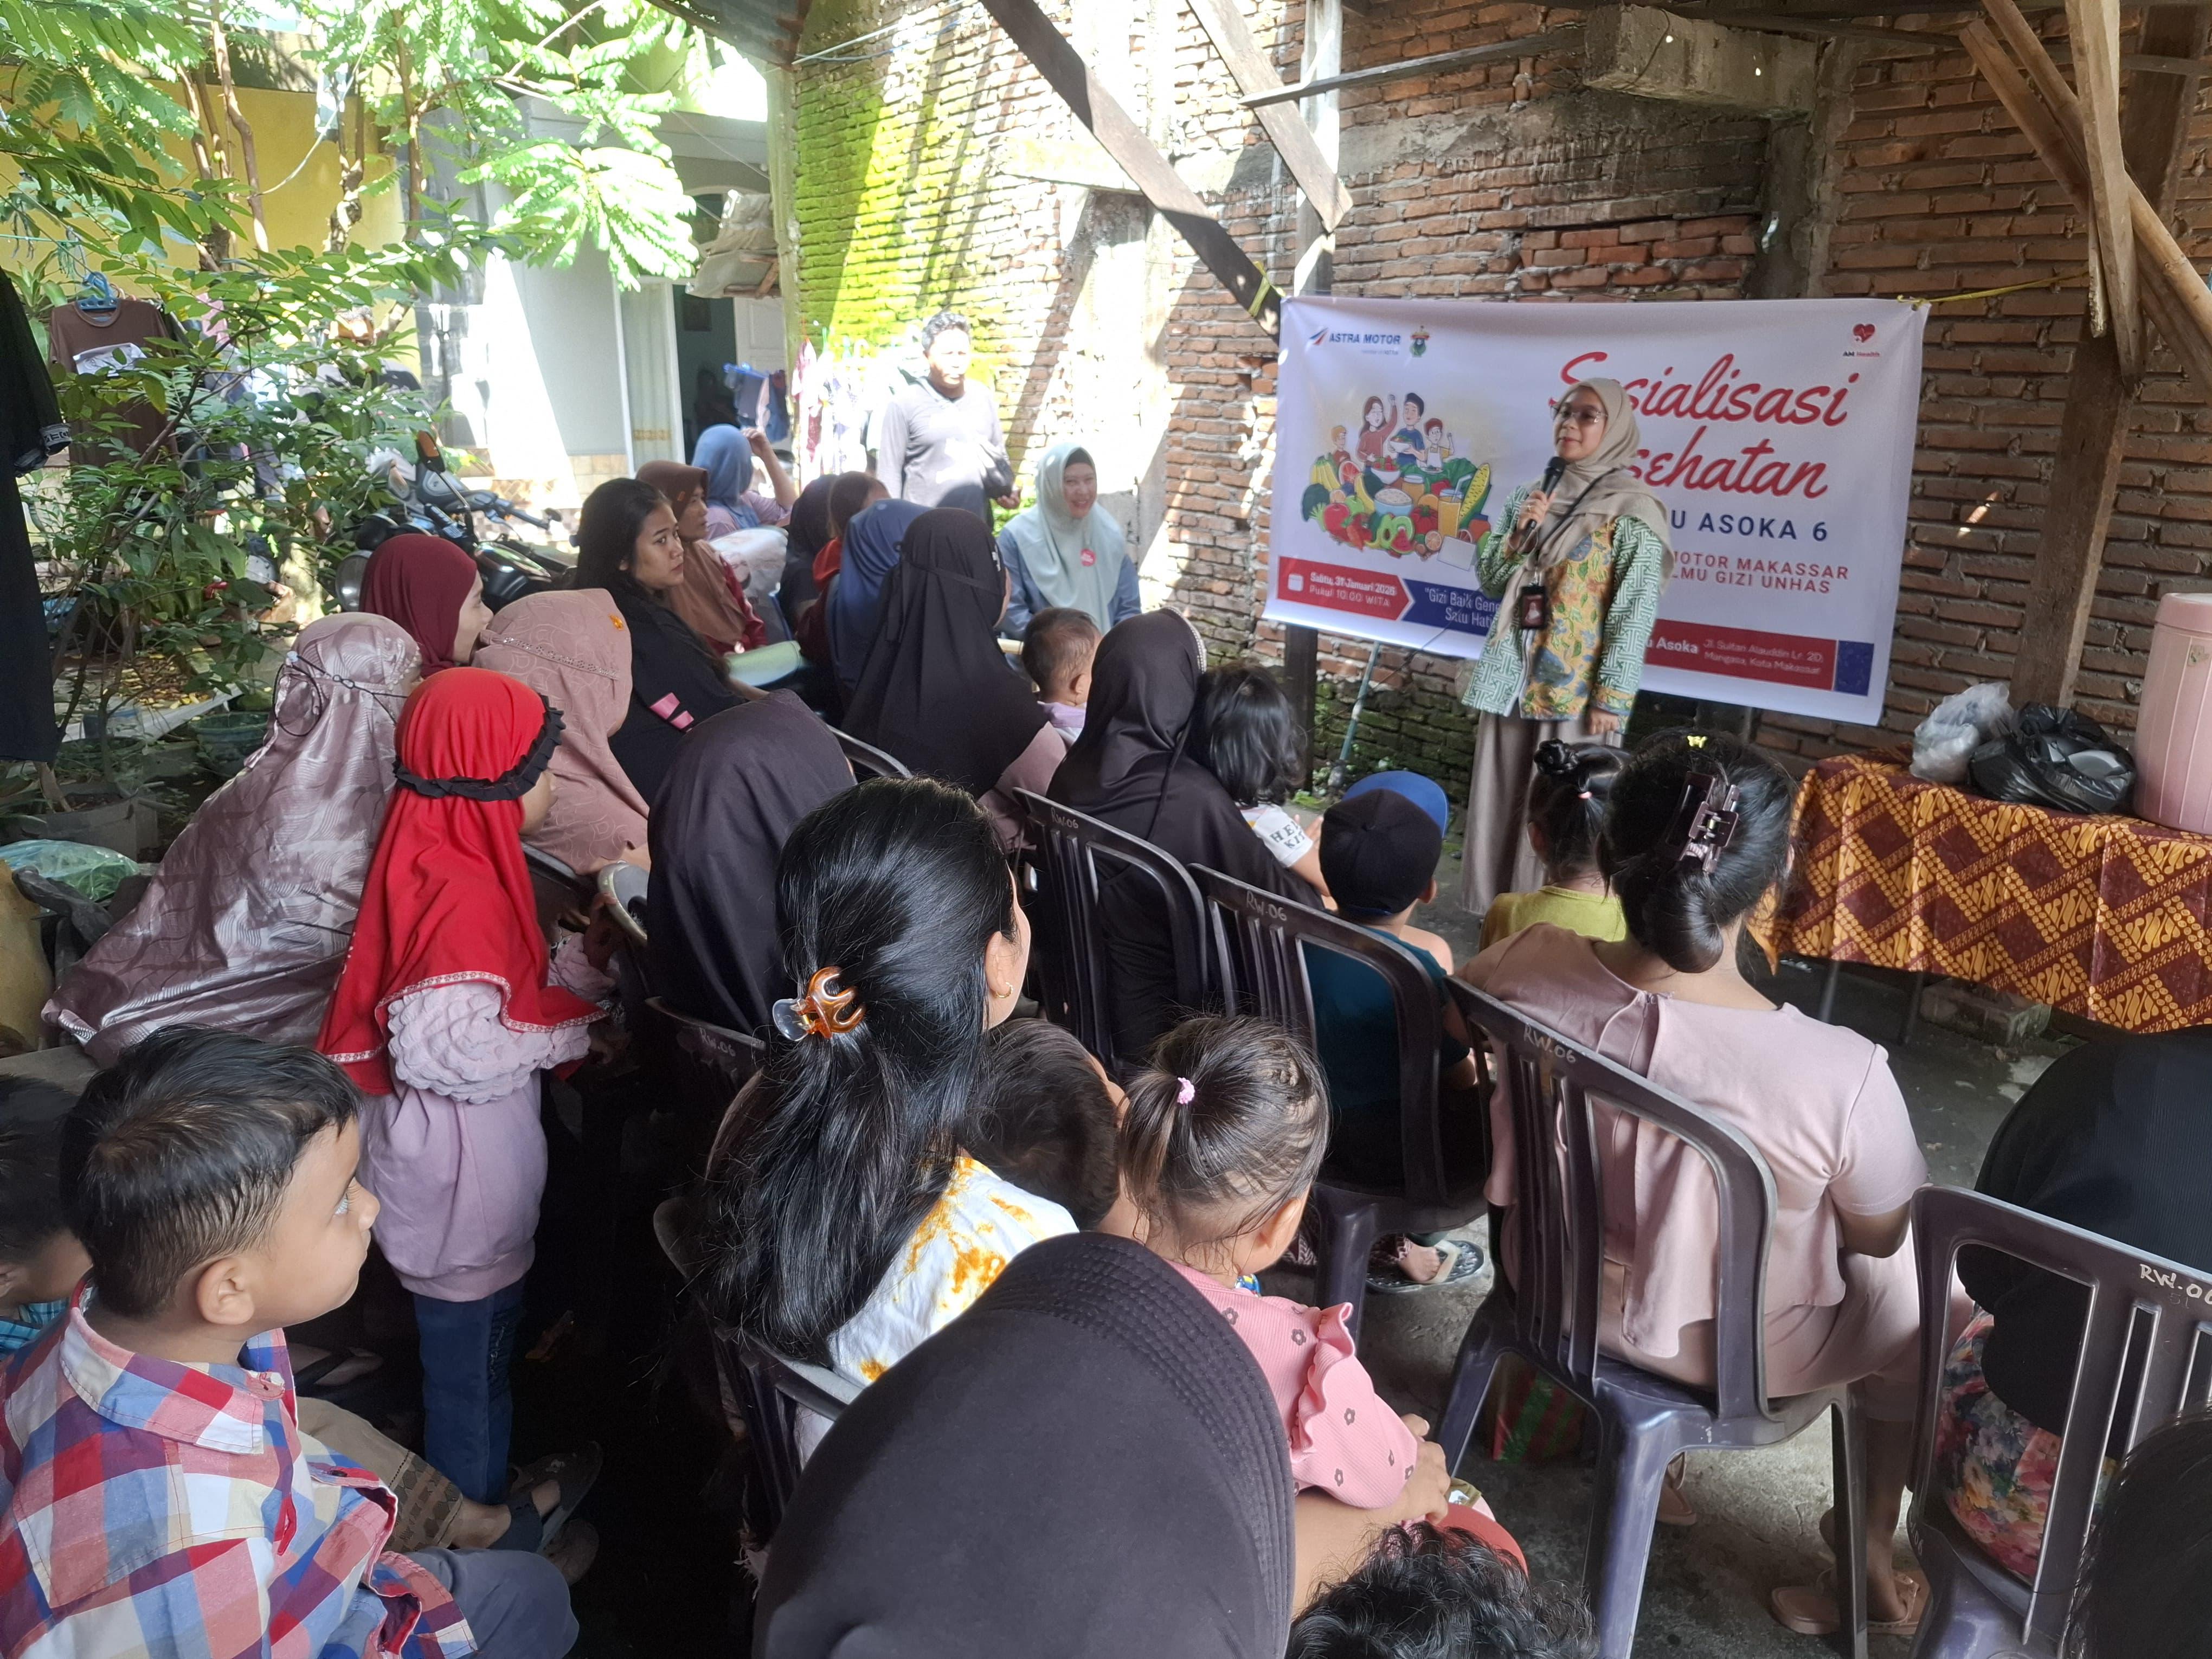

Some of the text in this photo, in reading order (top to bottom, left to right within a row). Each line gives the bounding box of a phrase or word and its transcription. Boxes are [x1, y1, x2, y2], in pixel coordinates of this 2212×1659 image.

[1329, 333, 1401, 345] ASTRA MOTOR
[1548, 351, 1860, 427] Ssialisasi
[1699, 512, 1797, 540] ASOKA
[1812, 521, 1828, 542] 6
[1737, 557, 1849, 580] MAKASSAR
[1715, 571, 1753, 587] GIZI
[1761, 576, 1831, 594] UNHAS
[1365, 595, 1390, 607] WITA
[1450, 591, 1472, 608] Baik
[1475, 596, 1501, 613] Gene
[1445, 607, 1468, 624] Satu
[1656, 636, 1698, 654] Asoka
[1051, 807, 1079, 828] RW.06
[1246, 890, 1287, 921] RW.06
[1523, 1023, 1576, 1064] RW.06
